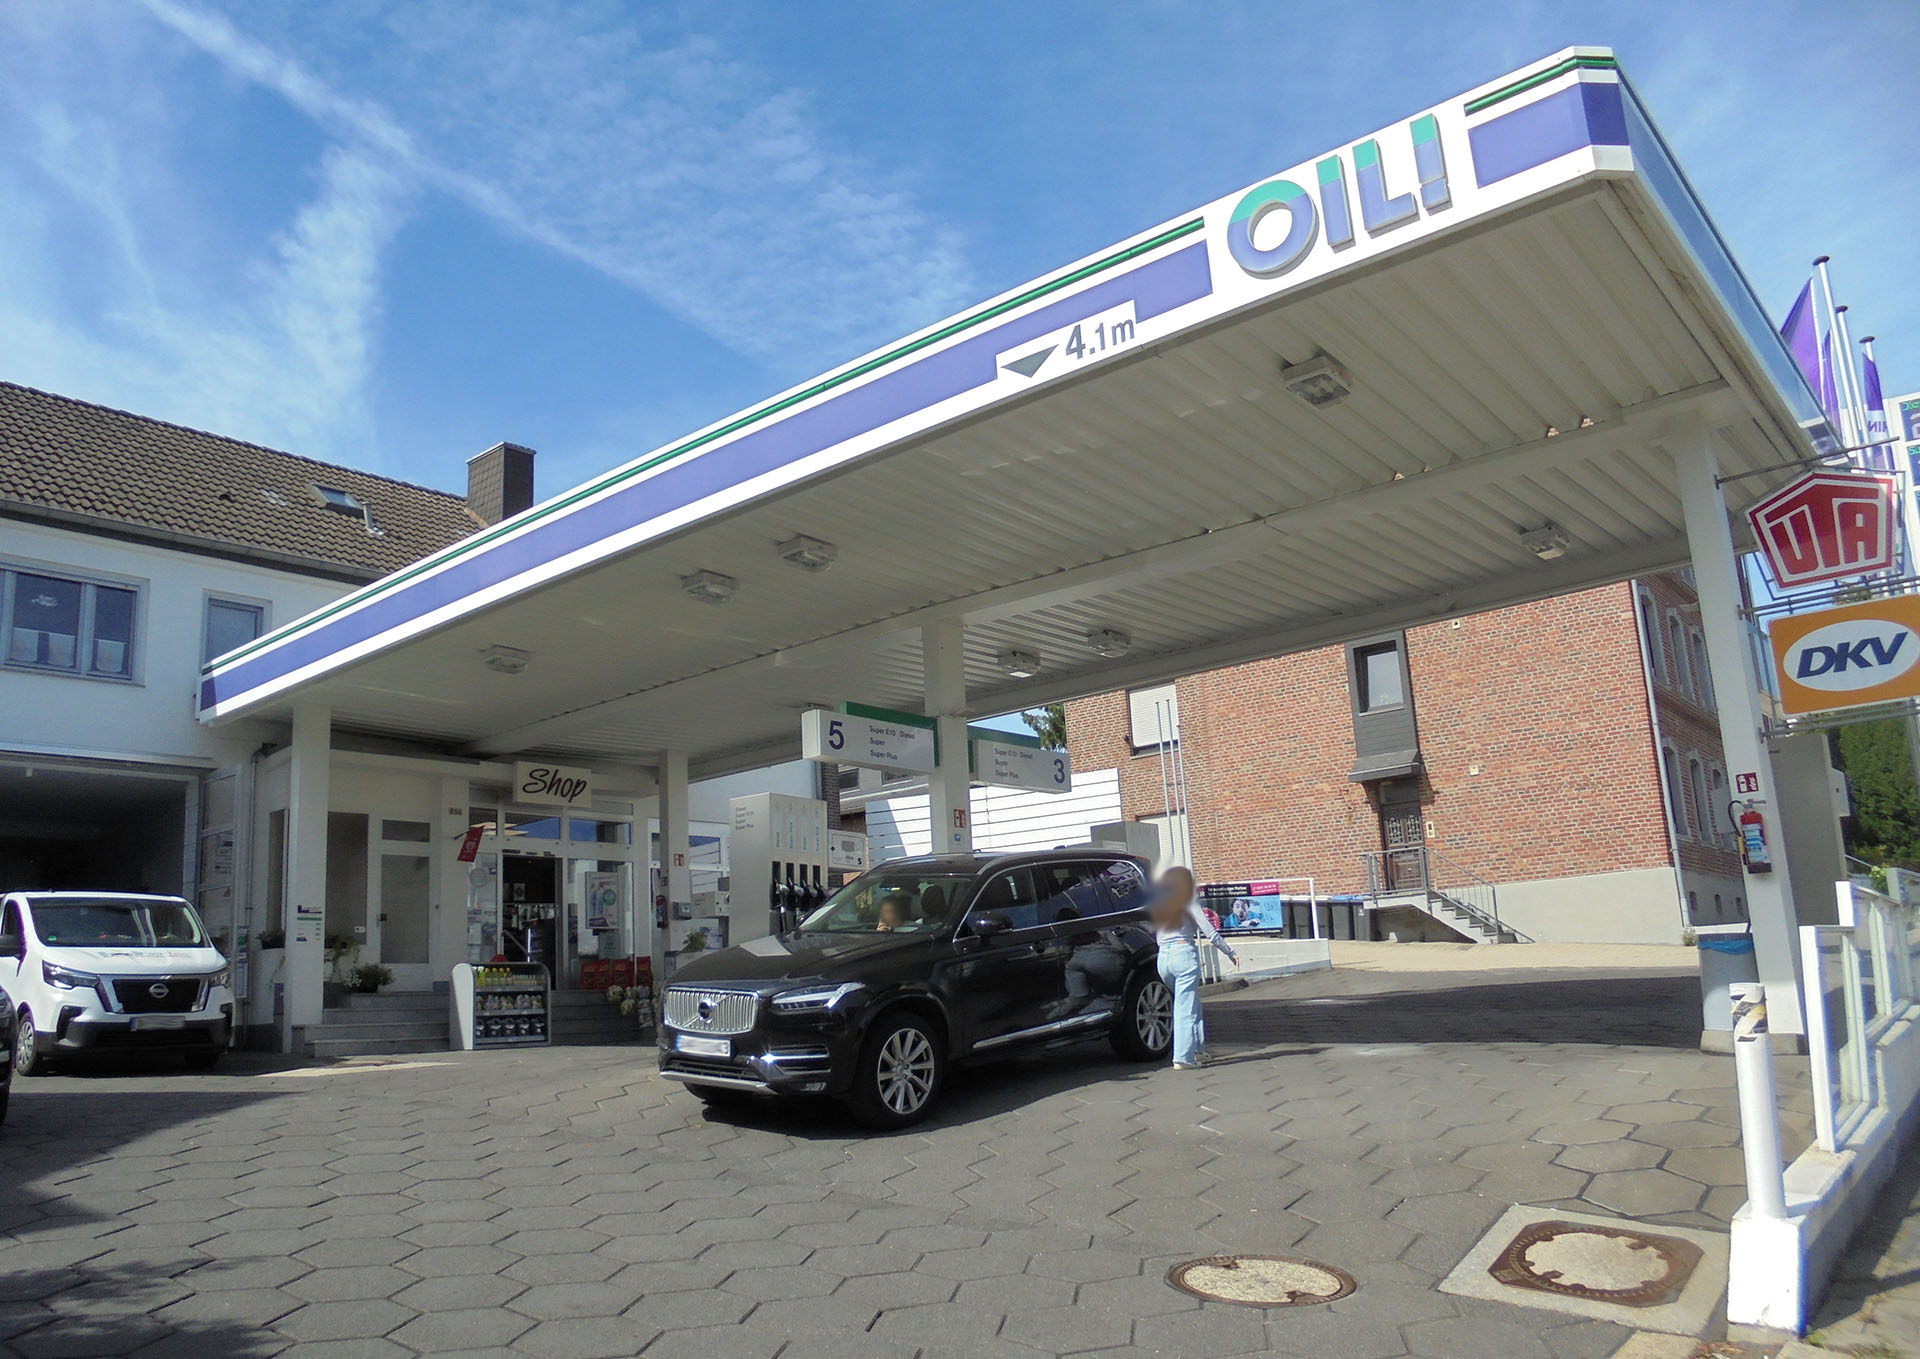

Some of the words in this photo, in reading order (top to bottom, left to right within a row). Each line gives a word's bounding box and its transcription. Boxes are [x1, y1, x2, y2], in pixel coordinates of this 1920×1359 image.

[1227, 113, 1451, 278] OIL!
[1766, 484, 1879, 575] UTA
[1797, 632, 1908, 679] DKV
[828, 720, 845, 750] 5
[869, 724, 886, 737] Super
[869, 736, 886, 747] Super
[870, 748, 887, 760] Super
[522, 768, 588, 803] Shop
[1053, 758, 1066, 784] 3
